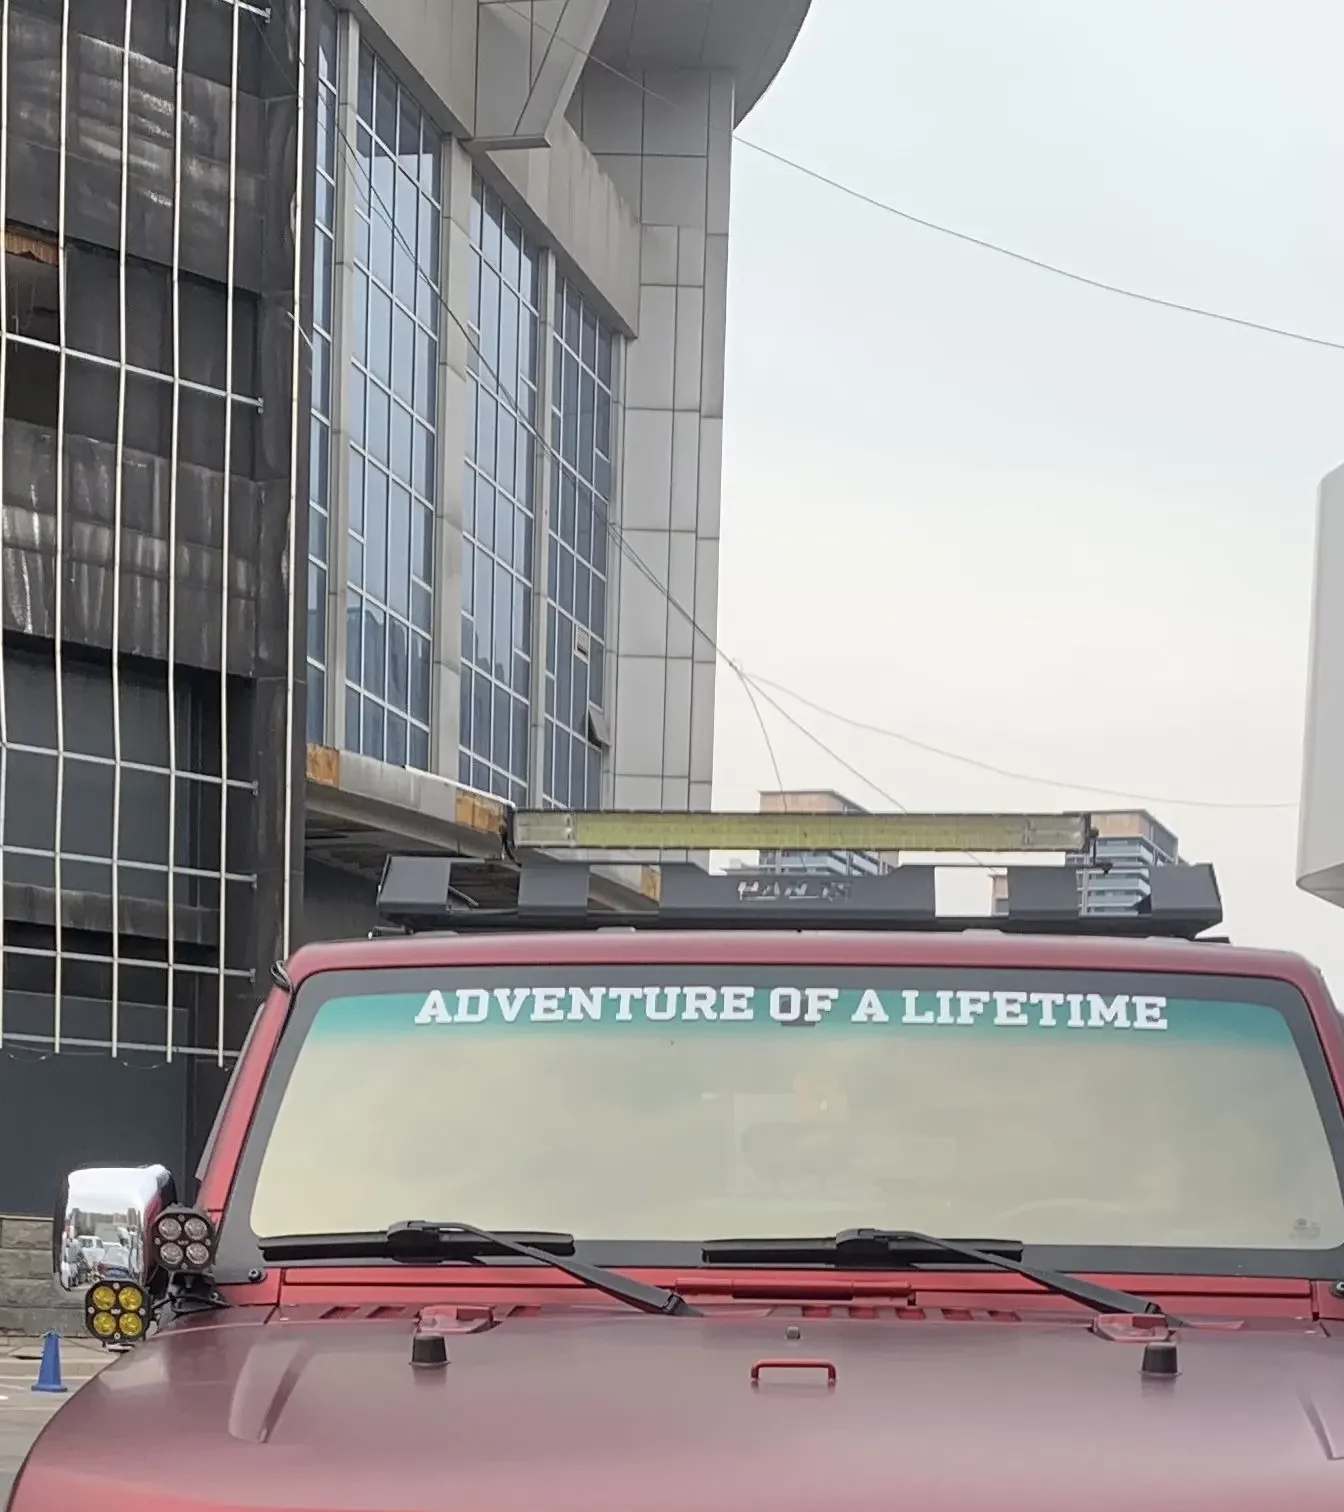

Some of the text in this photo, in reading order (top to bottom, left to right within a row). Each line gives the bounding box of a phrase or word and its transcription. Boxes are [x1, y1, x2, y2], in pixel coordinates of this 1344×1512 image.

[413, 986, 1169, 1030] ADVENTURE OF A LIFETIME
